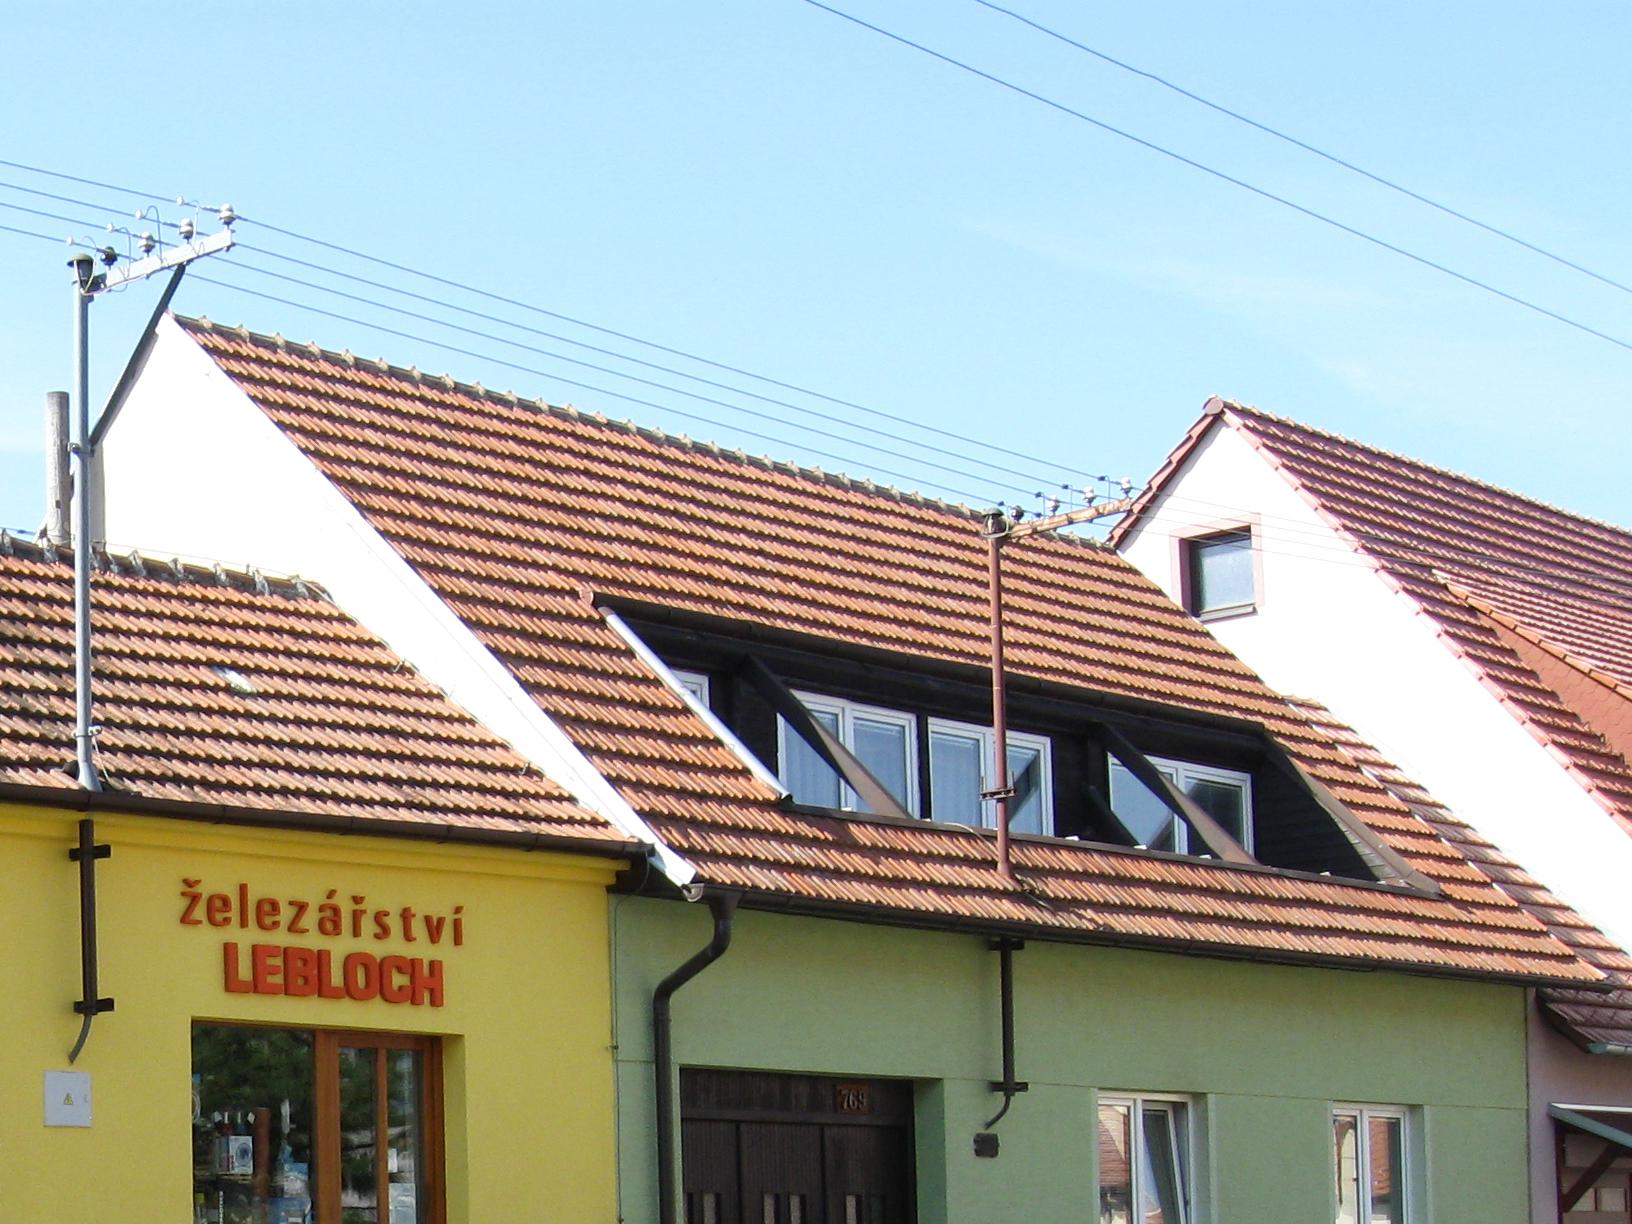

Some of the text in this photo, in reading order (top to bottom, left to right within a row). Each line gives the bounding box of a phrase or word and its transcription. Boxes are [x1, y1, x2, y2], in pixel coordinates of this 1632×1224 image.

[179, 878, 465, 946] železářství
[222, 942, 445, 1007] LEBLOCH
[840, 1088, 866, 1110] 769
